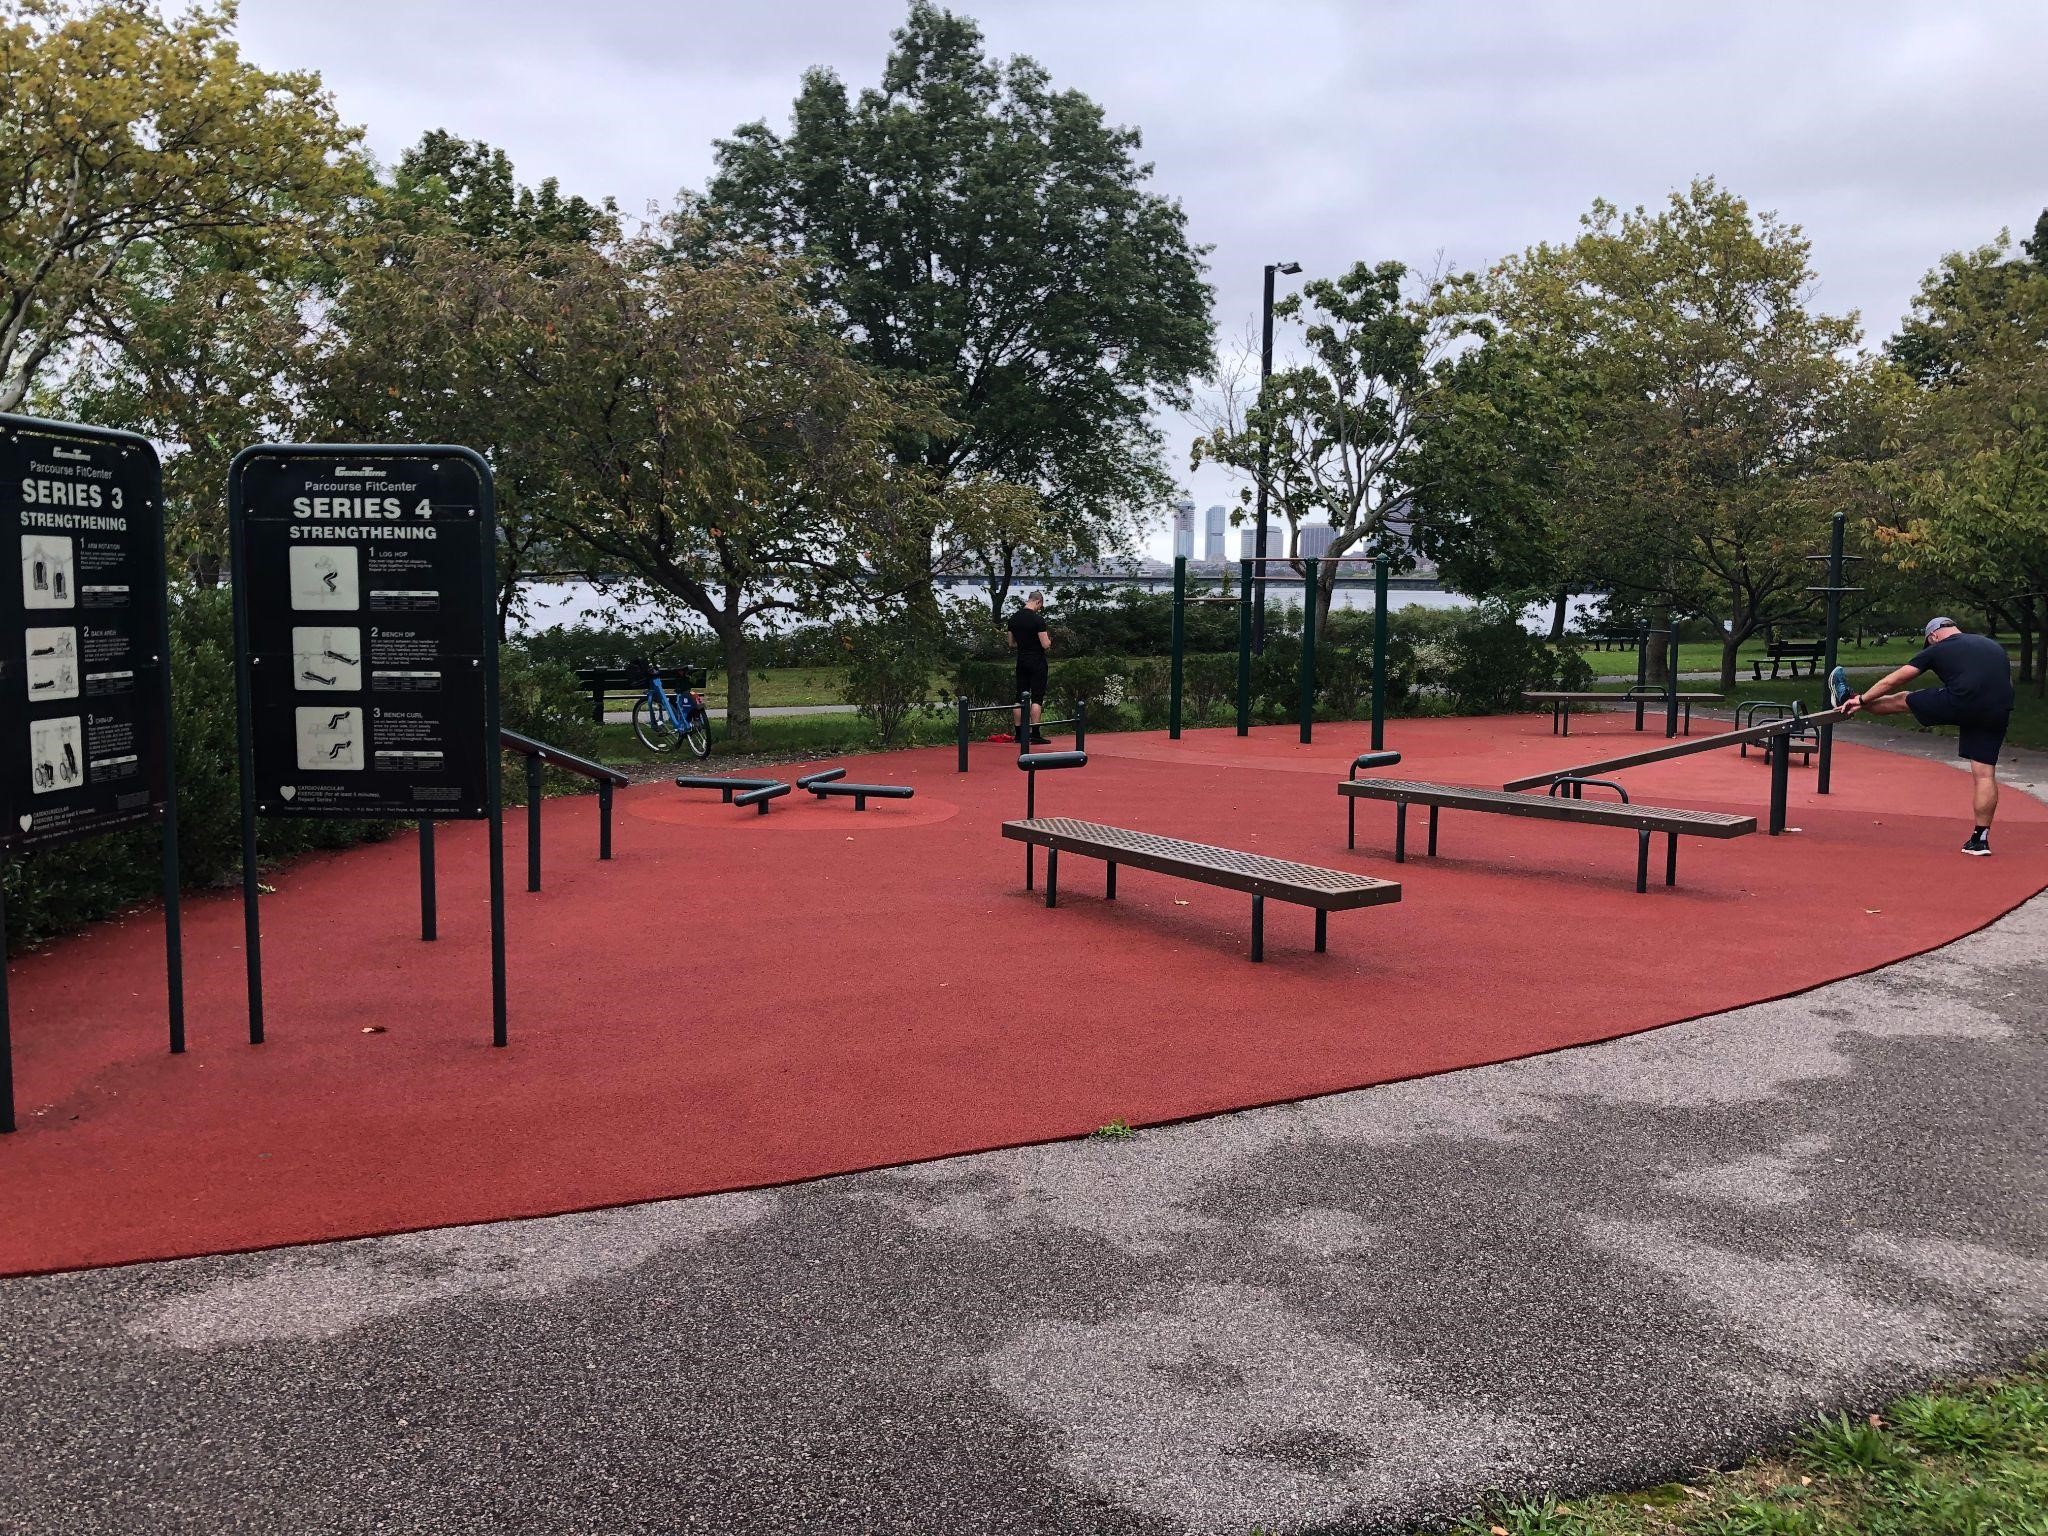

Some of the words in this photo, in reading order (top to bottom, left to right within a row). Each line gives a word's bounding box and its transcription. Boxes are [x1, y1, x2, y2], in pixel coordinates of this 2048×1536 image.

[30, 460, 74, 476] Parcourse
[76, 465, 113, 480] FitCenter
[334, 466, 387, 477] GameTime
[304, 481, 362, 492] Parcourse
[365, 481, 417, 492] FitCenter
[22, 478, 102, 508] SERIES
[111, 487, 123, 509] 3
[293, 497, 402, 519] SERIES
[414, 498, 433, 519] 4
[20, 511, 127, 531] STRENGTHENING
[289, 525, 437, 540] STRENGTHENING
[79, 537, 85, 549] 1
[368, 546, 375, 557] 1
[83, 625, 90, 637] 2
[370, 626, 379, 637] 2
[373, 707, 381, 718] 3
[87, 713, 94, 725] 3
